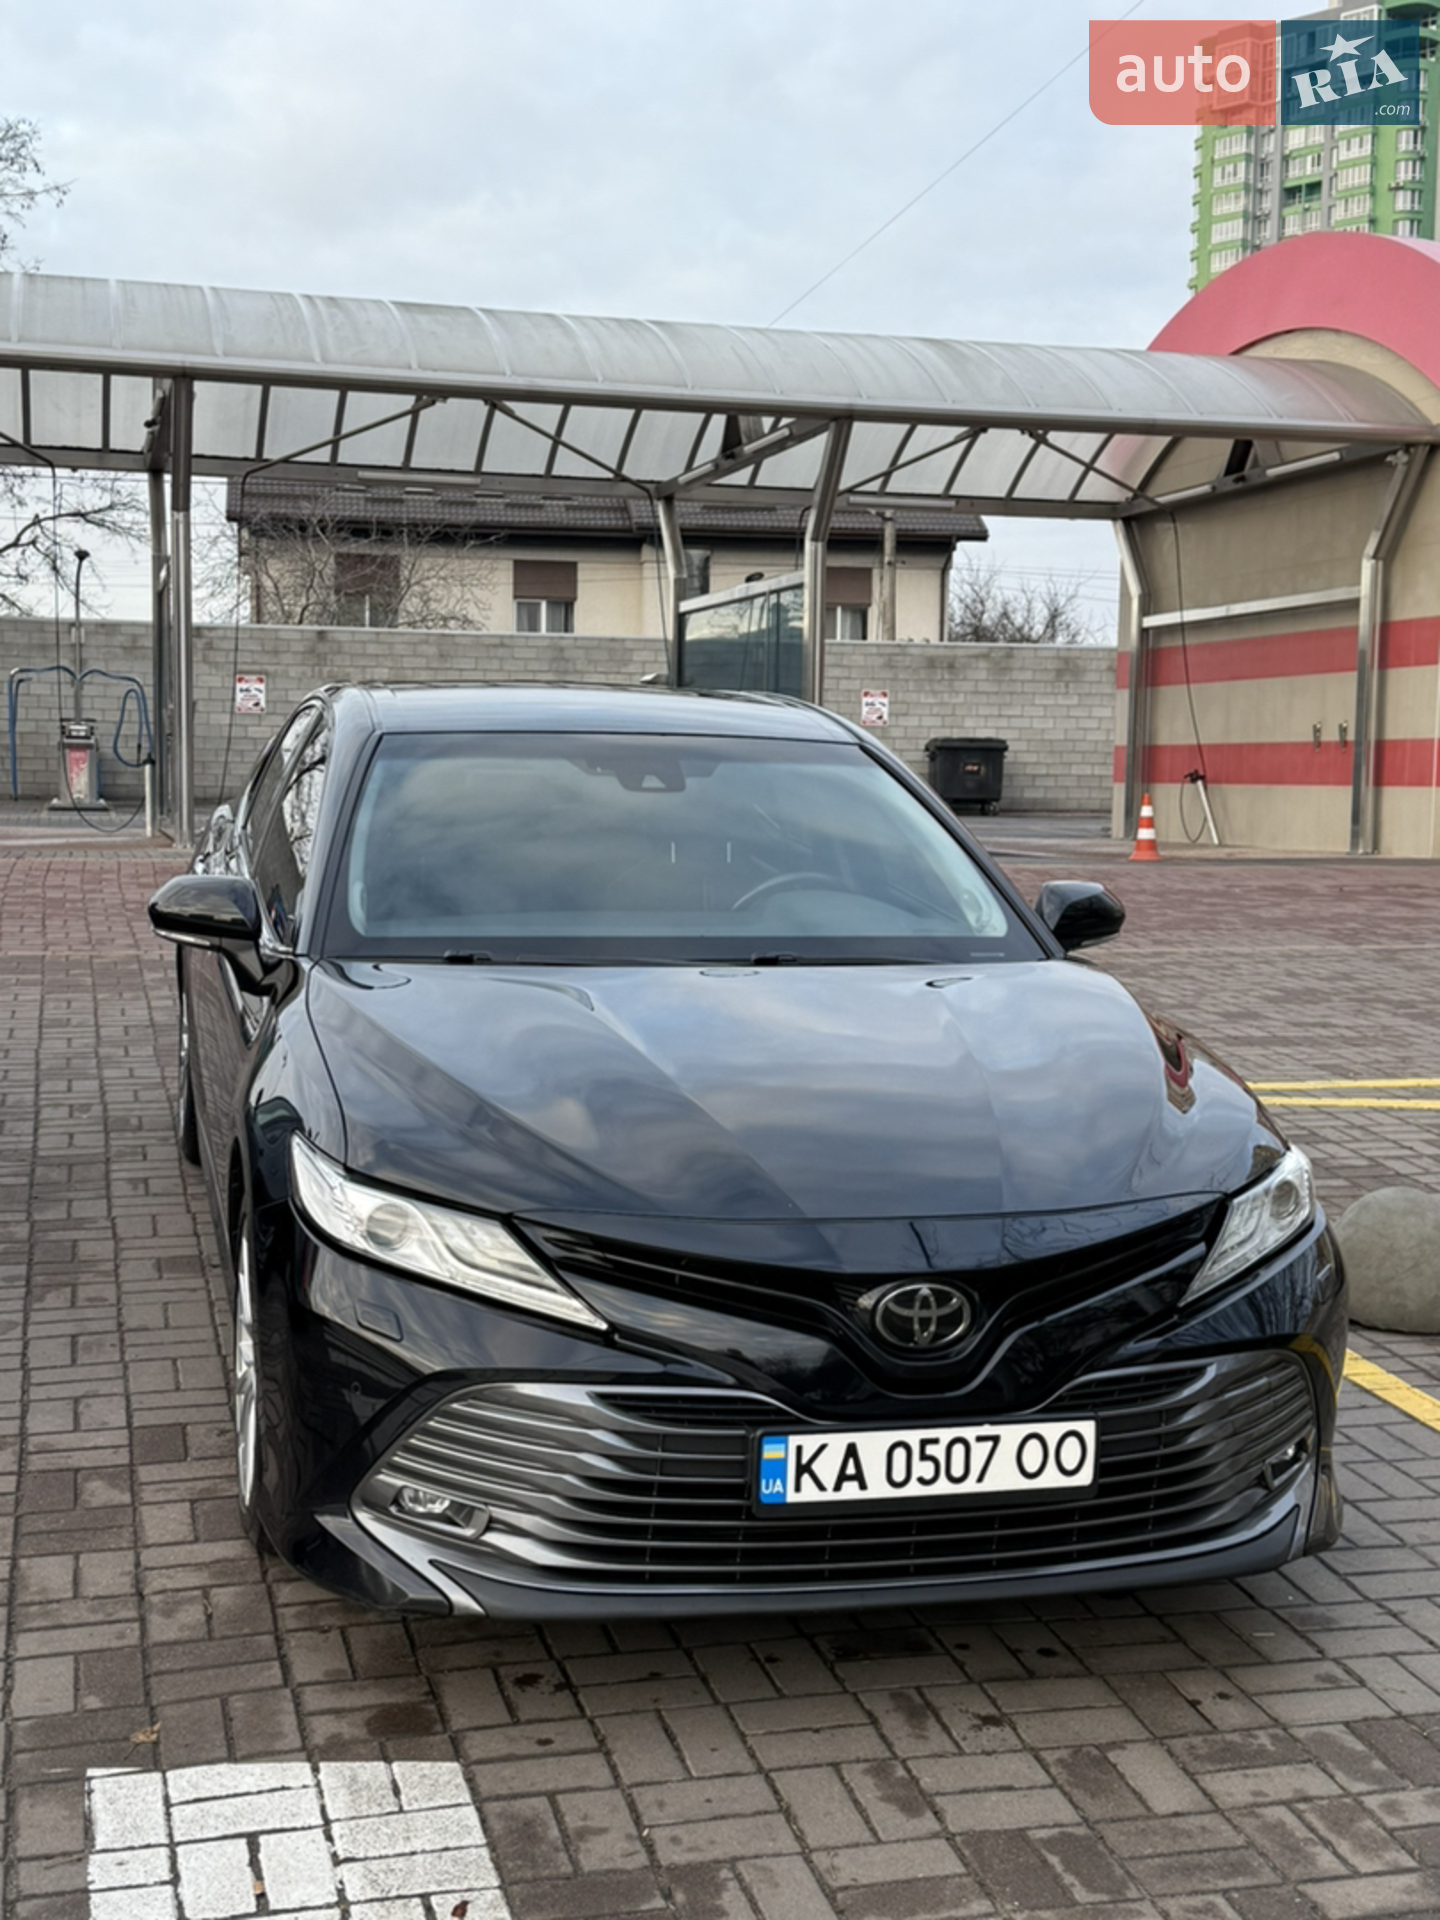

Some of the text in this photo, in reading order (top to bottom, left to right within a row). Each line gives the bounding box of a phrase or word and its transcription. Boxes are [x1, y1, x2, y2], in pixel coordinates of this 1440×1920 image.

[794, 1429, 1087, 1493] KA 0507 OO
[761, 1479, 784, 1494] UA
